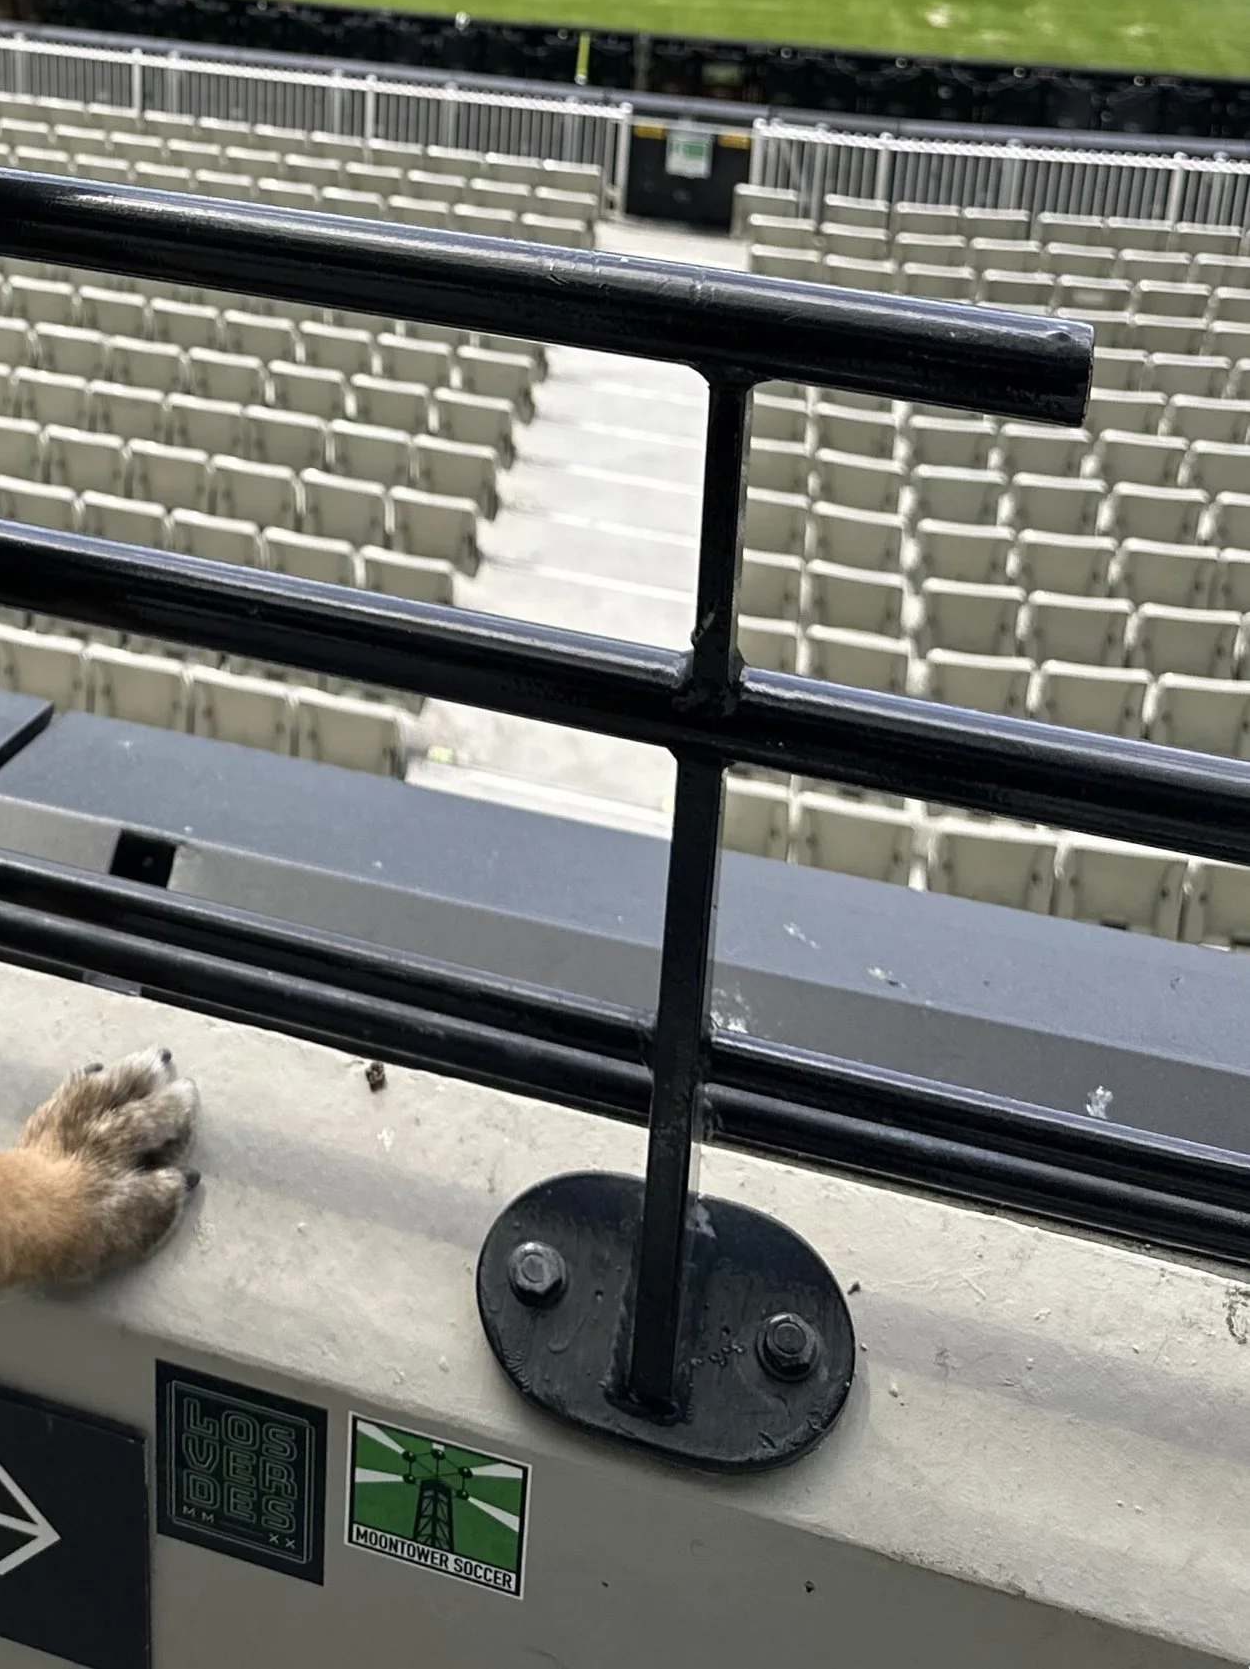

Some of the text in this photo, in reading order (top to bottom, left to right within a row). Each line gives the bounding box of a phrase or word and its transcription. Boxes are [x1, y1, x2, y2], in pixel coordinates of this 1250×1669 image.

[183, 1396, 298, 1463] LOS
[181, 1432, 298, 1500] VER
[182, 1468, 295, 1533] DES
[355, 1524, 514, 1590] MOONTOWER SOCCER
